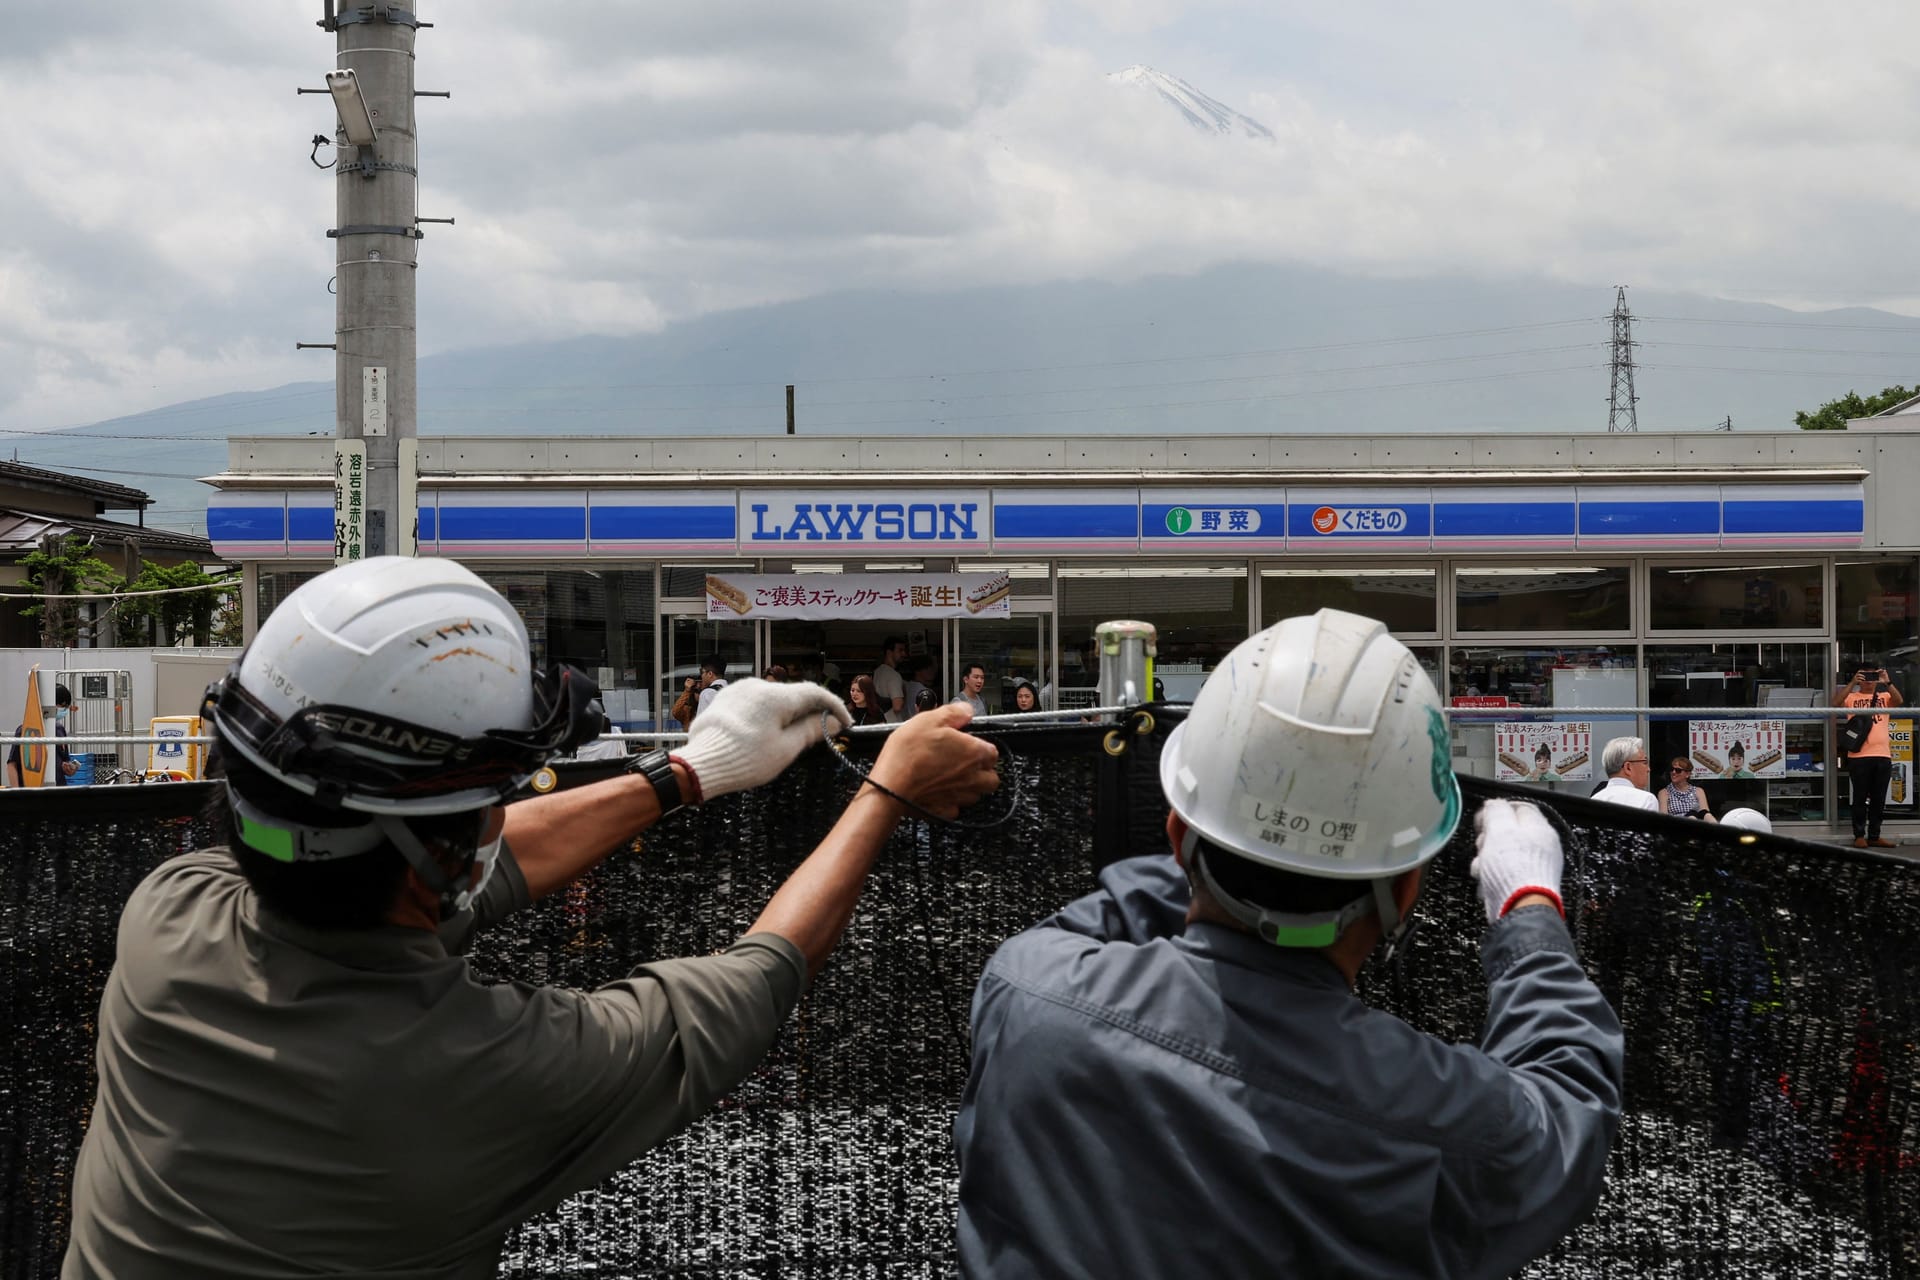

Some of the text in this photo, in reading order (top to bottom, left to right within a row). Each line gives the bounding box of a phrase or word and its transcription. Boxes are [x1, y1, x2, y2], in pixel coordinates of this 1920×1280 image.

[349, 453, 361, 560] 溶岩遠赤外線
[1201, 510, 1249, 530] 野菜
[1342, 510, 1401, 530] くだもの
[752, 504, 977, 540] LAWSON
[1255, 803, 1309, 832] しまの
